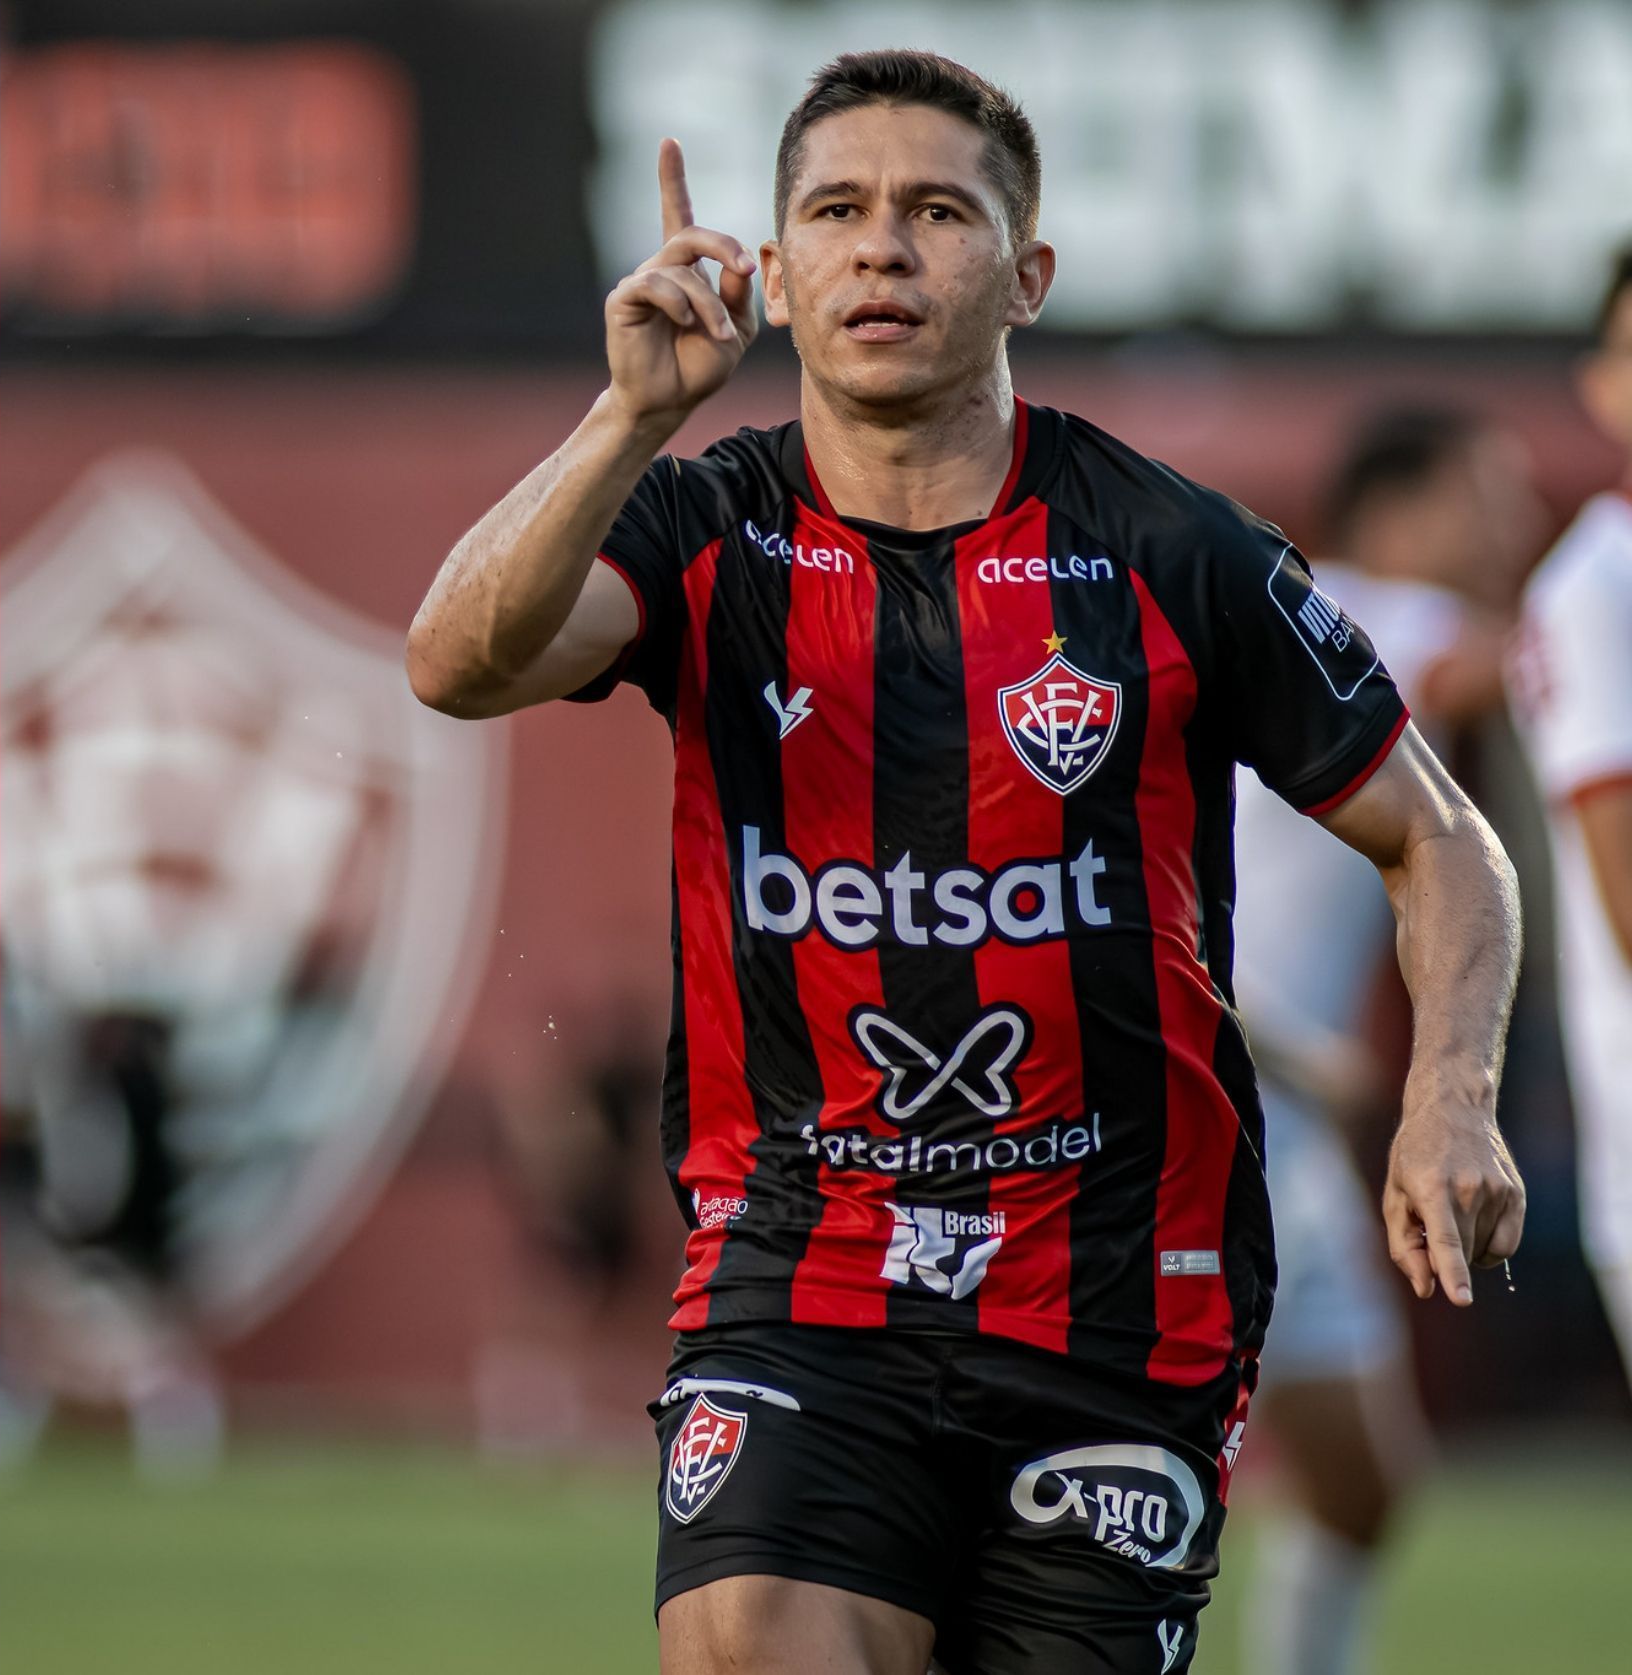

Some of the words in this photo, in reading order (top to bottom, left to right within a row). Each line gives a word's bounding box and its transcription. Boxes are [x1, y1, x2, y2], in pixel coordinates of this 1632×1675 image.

[746, 519, 854, 574] acelen
[977, 555, 1113, 583] acelen
[743, 825, 1112, 946] betsat
[801, 1112, 1102, 1173] fatalmodel
[945, 1211, 1006, 1235] Brasil
[1163, 1263, 1181, 1271] VOLT
[1103, 1530, 1152, 1564] Zero
